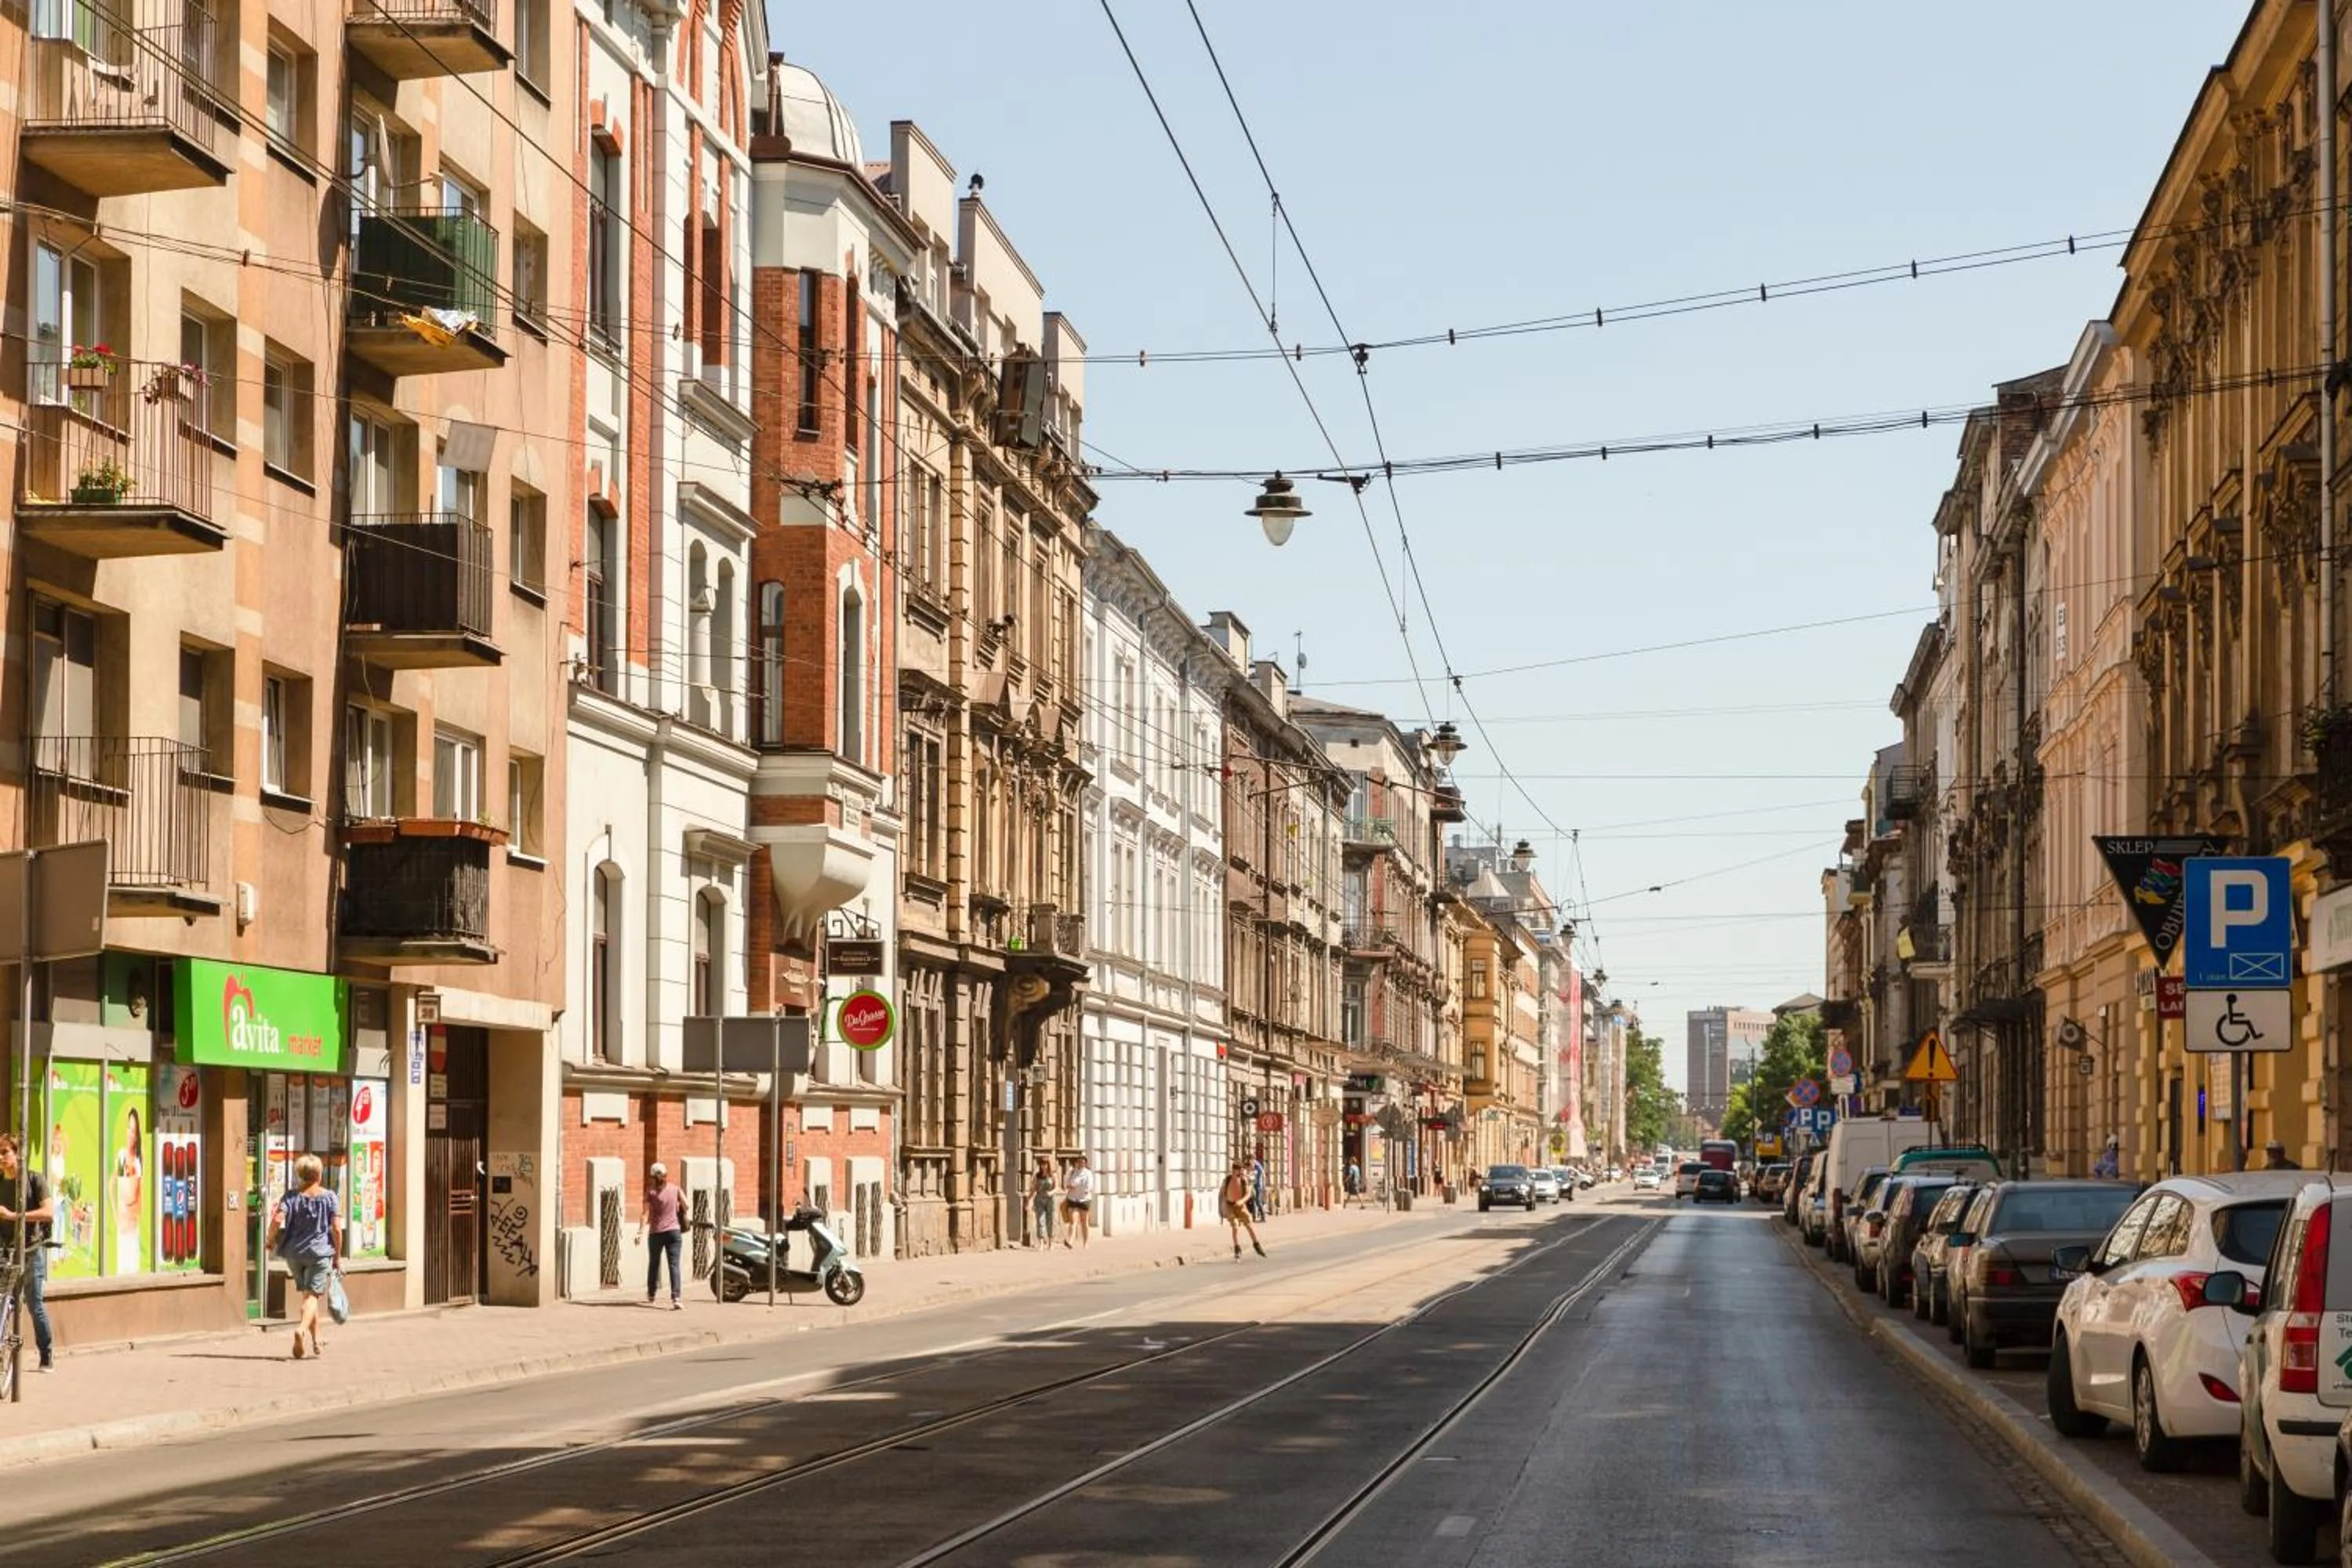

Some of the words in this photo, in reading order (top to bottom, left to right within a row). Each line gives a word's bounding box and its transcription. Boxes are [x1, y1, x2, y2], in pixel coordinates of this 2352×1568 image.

[2107, 840, 2154, 854] SKLEP
[2210, 869, 2269, 949] P
[231, 1004, 280, 1054] avita
[289, 1029, 323, 1057] market
[1800, 1108, 1813, 1125] P
[1817, 1110, 1831, 1130] P
